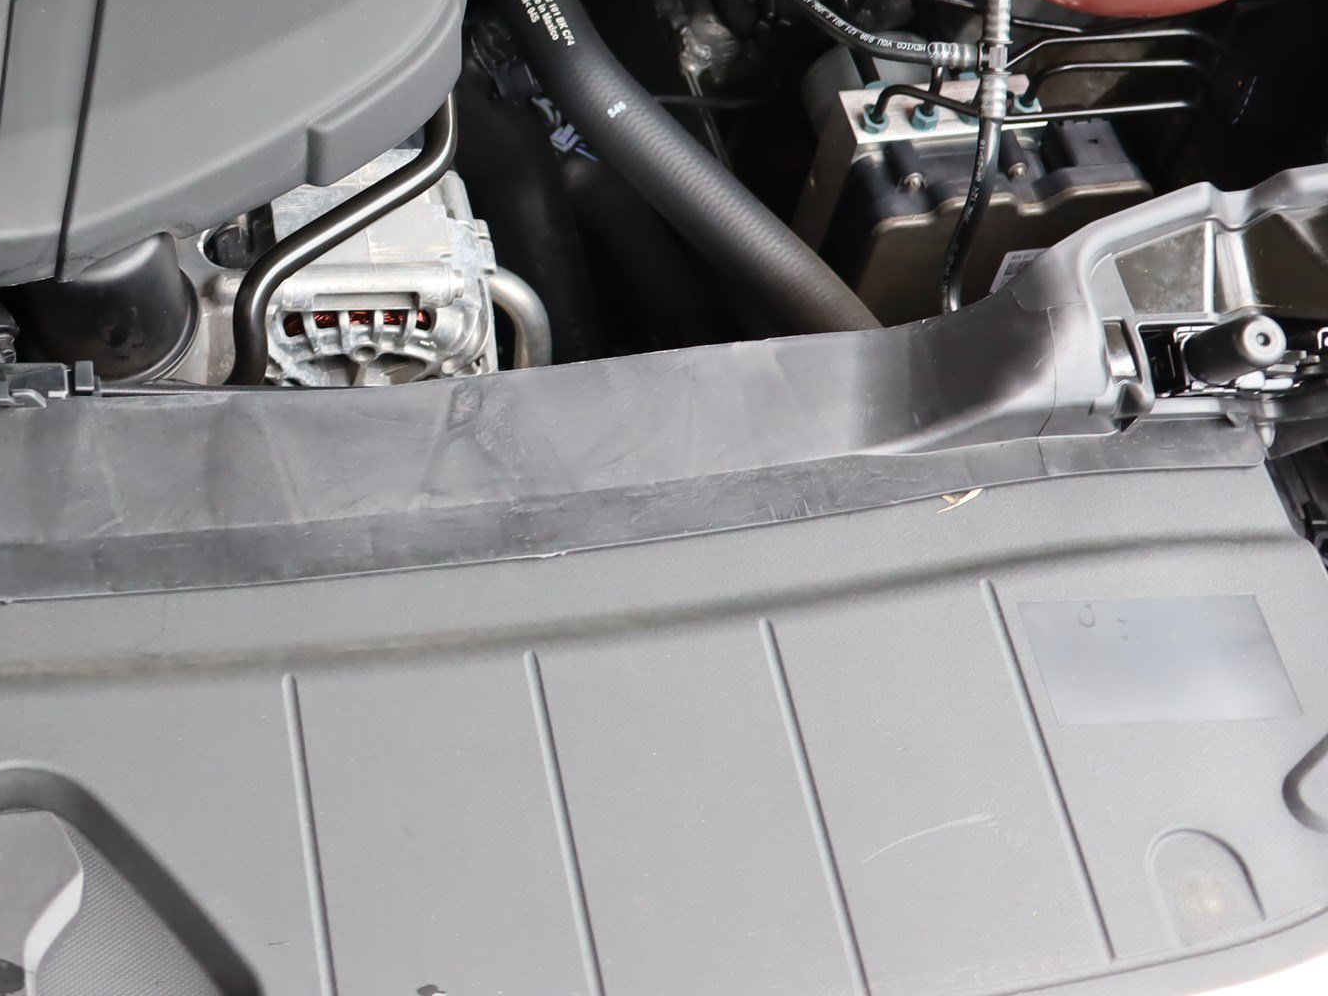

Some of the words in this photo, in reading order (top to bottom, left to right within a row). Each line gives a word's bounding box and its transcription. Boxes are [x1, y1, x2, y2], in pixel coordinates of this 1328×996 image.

[538, 4, 546, 14] in
[542, 13, 559, 41] Mexico
[549, 3, 561, 16] 101
[556, 16, 568, 30] BK
[562, 29, 575, 47] CF4
[897, 41, 926, 51] MEXICO
